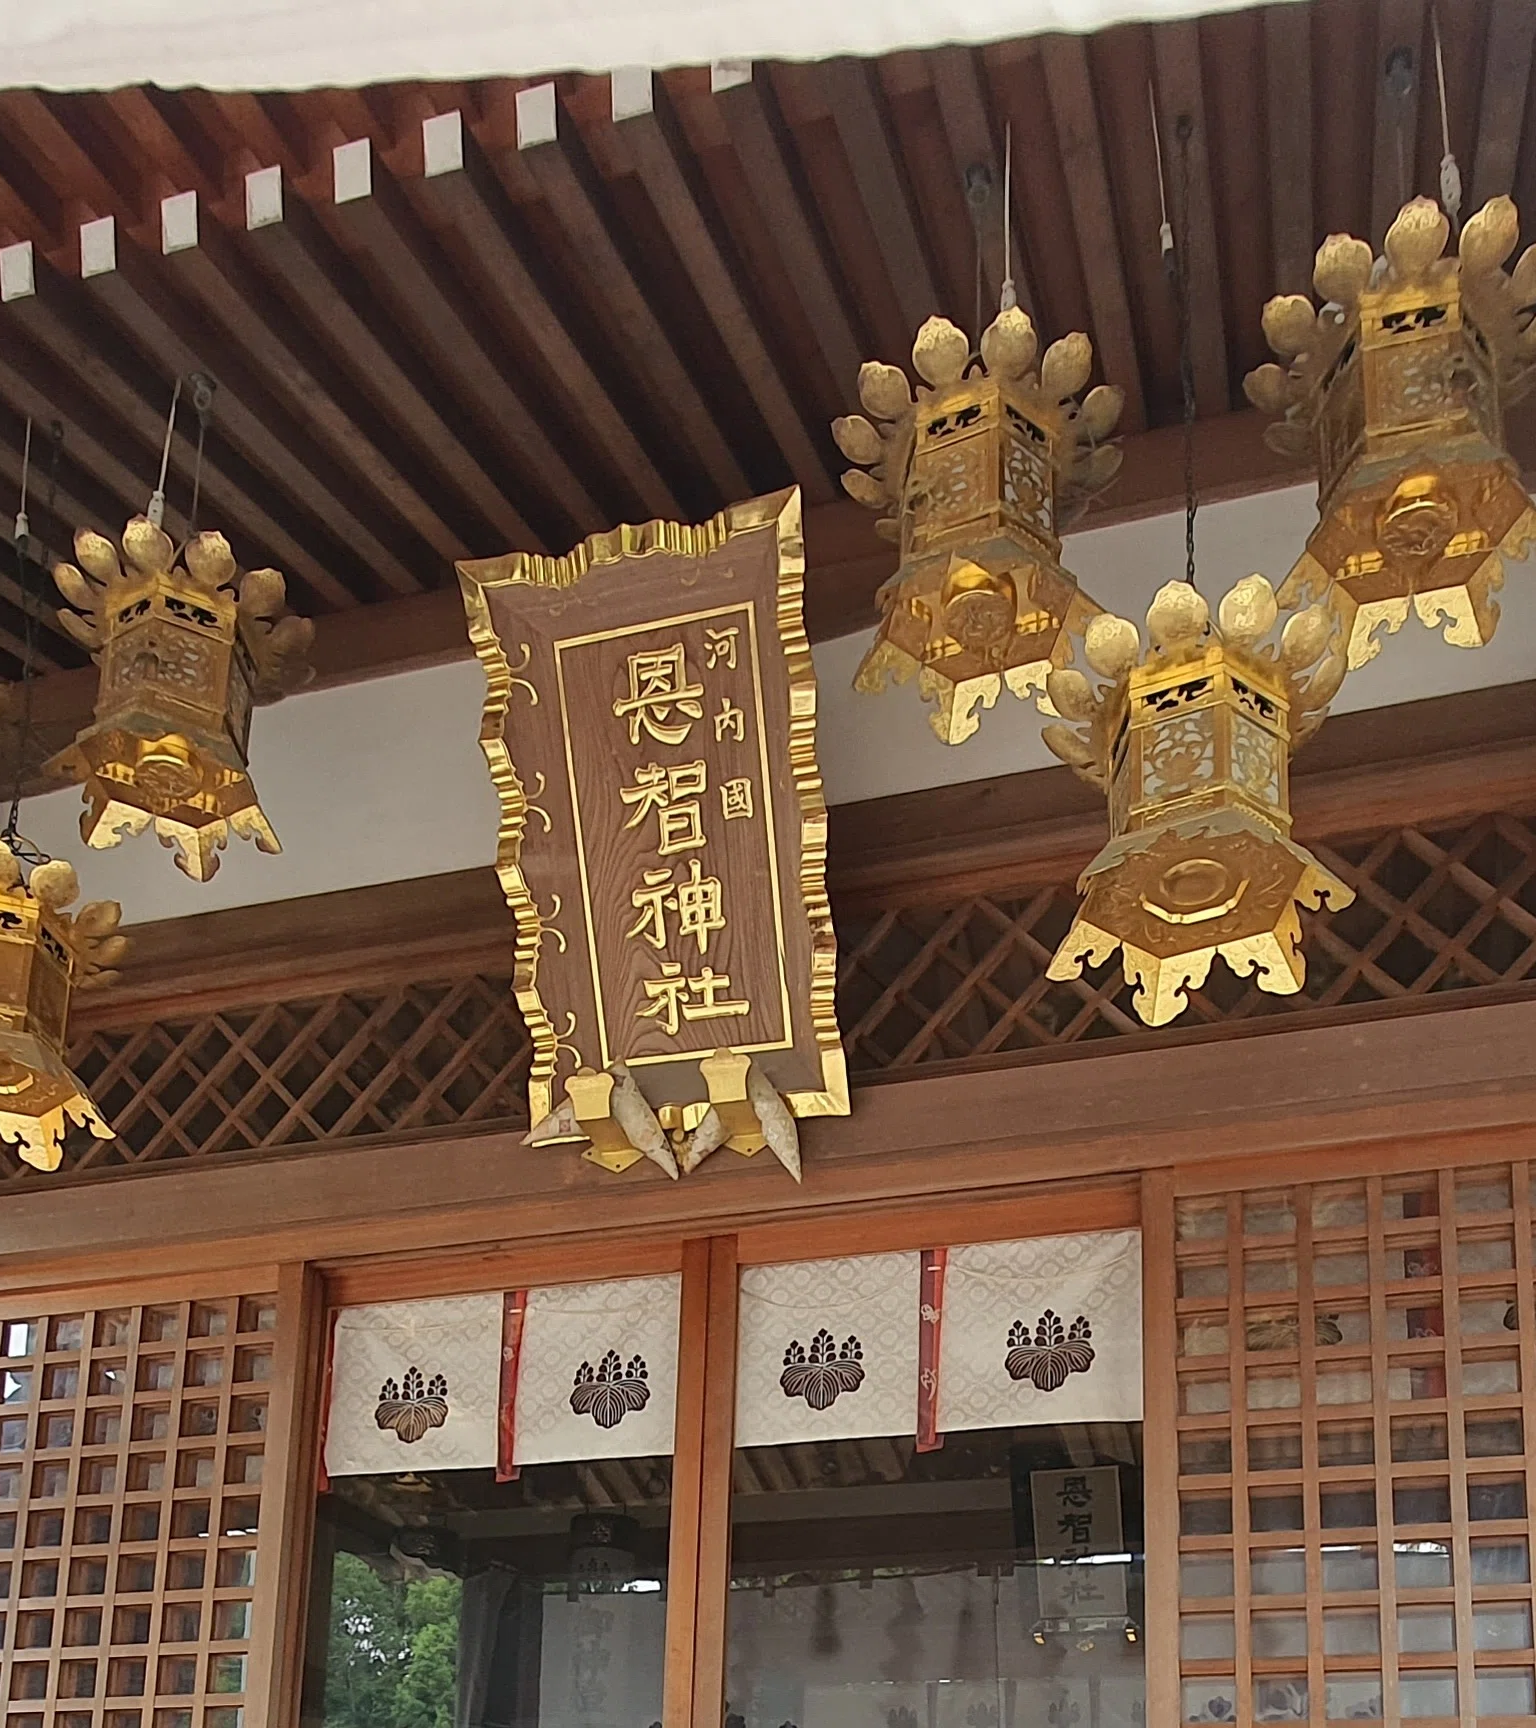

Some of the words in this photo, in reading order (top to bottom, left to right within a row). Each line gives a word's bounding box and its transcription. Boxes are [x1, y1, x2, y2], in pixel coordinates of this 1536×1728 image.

[611, 641, 752, 1037] 恩智神社
[703, 624, 756, 821] 河内國
